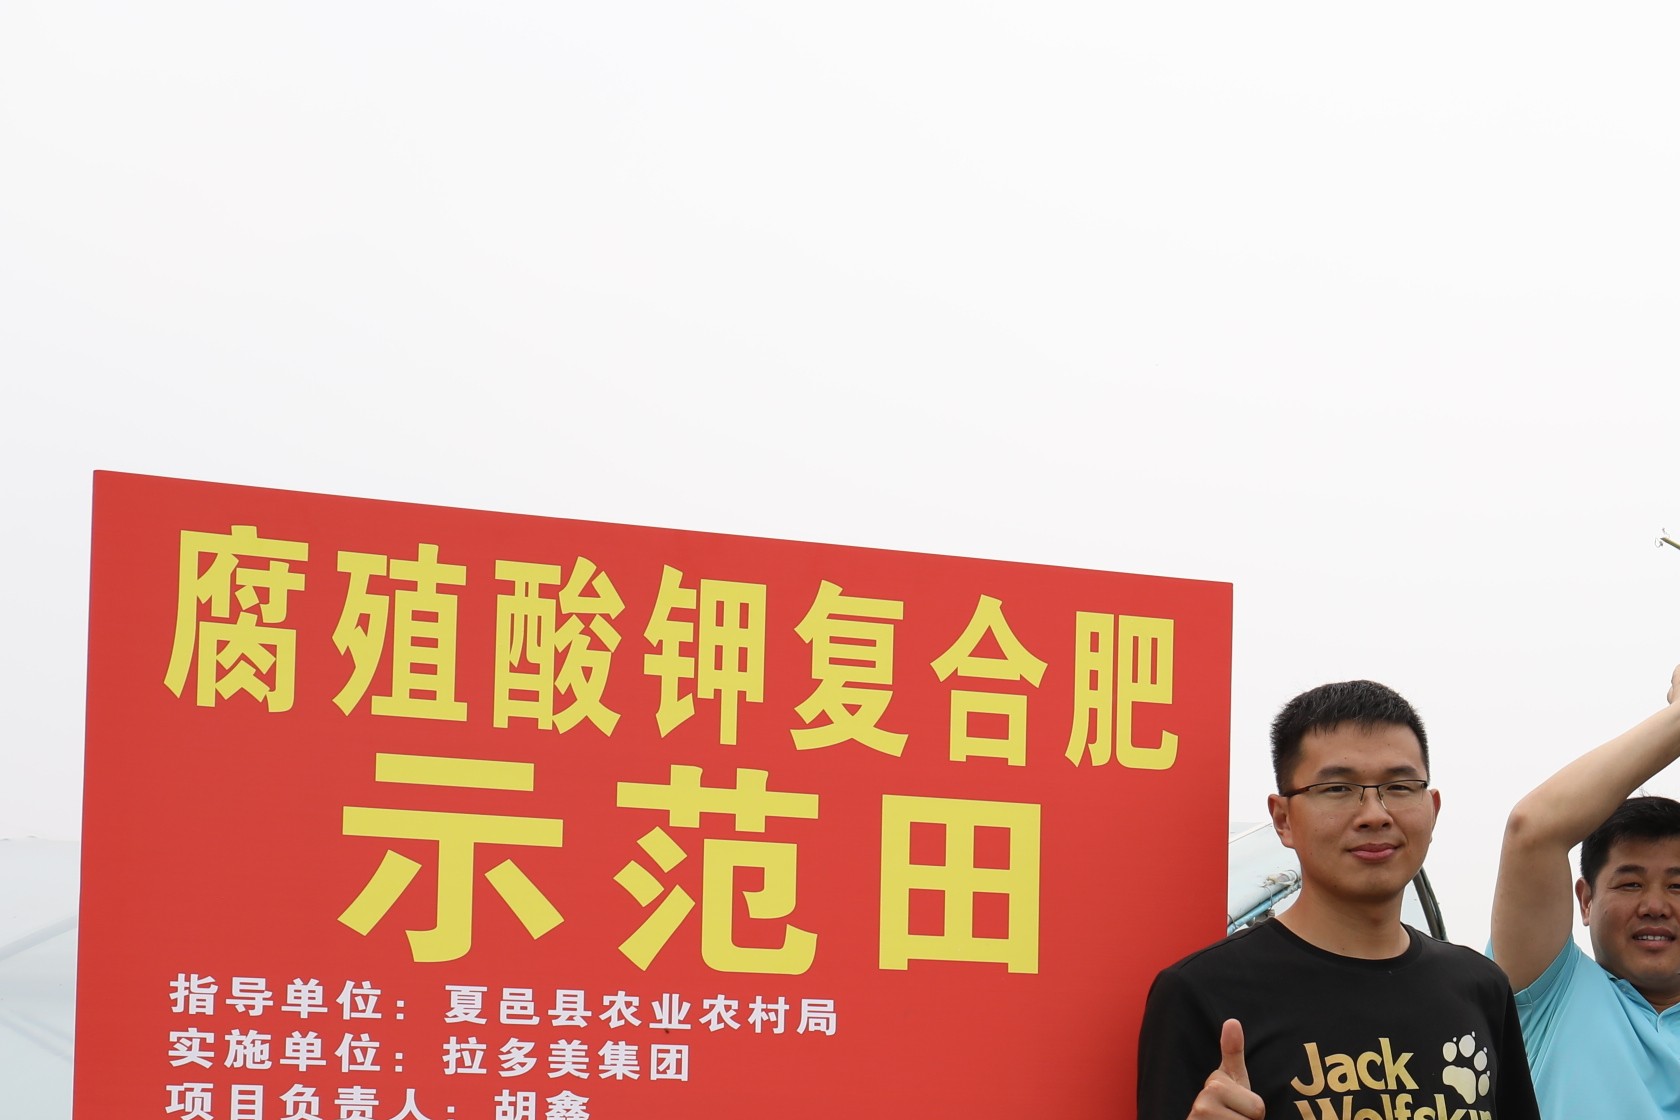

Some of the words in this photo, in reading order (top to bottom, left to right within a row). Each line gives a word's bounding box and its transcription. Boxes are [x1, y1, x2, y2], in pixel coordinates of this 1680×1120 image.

[164, 524, 1179, 771] 腐殖酸钾复合肥
[337, 752, 1041, 976] 示范田
[1290, 1037, 1419, 1096] Jack
